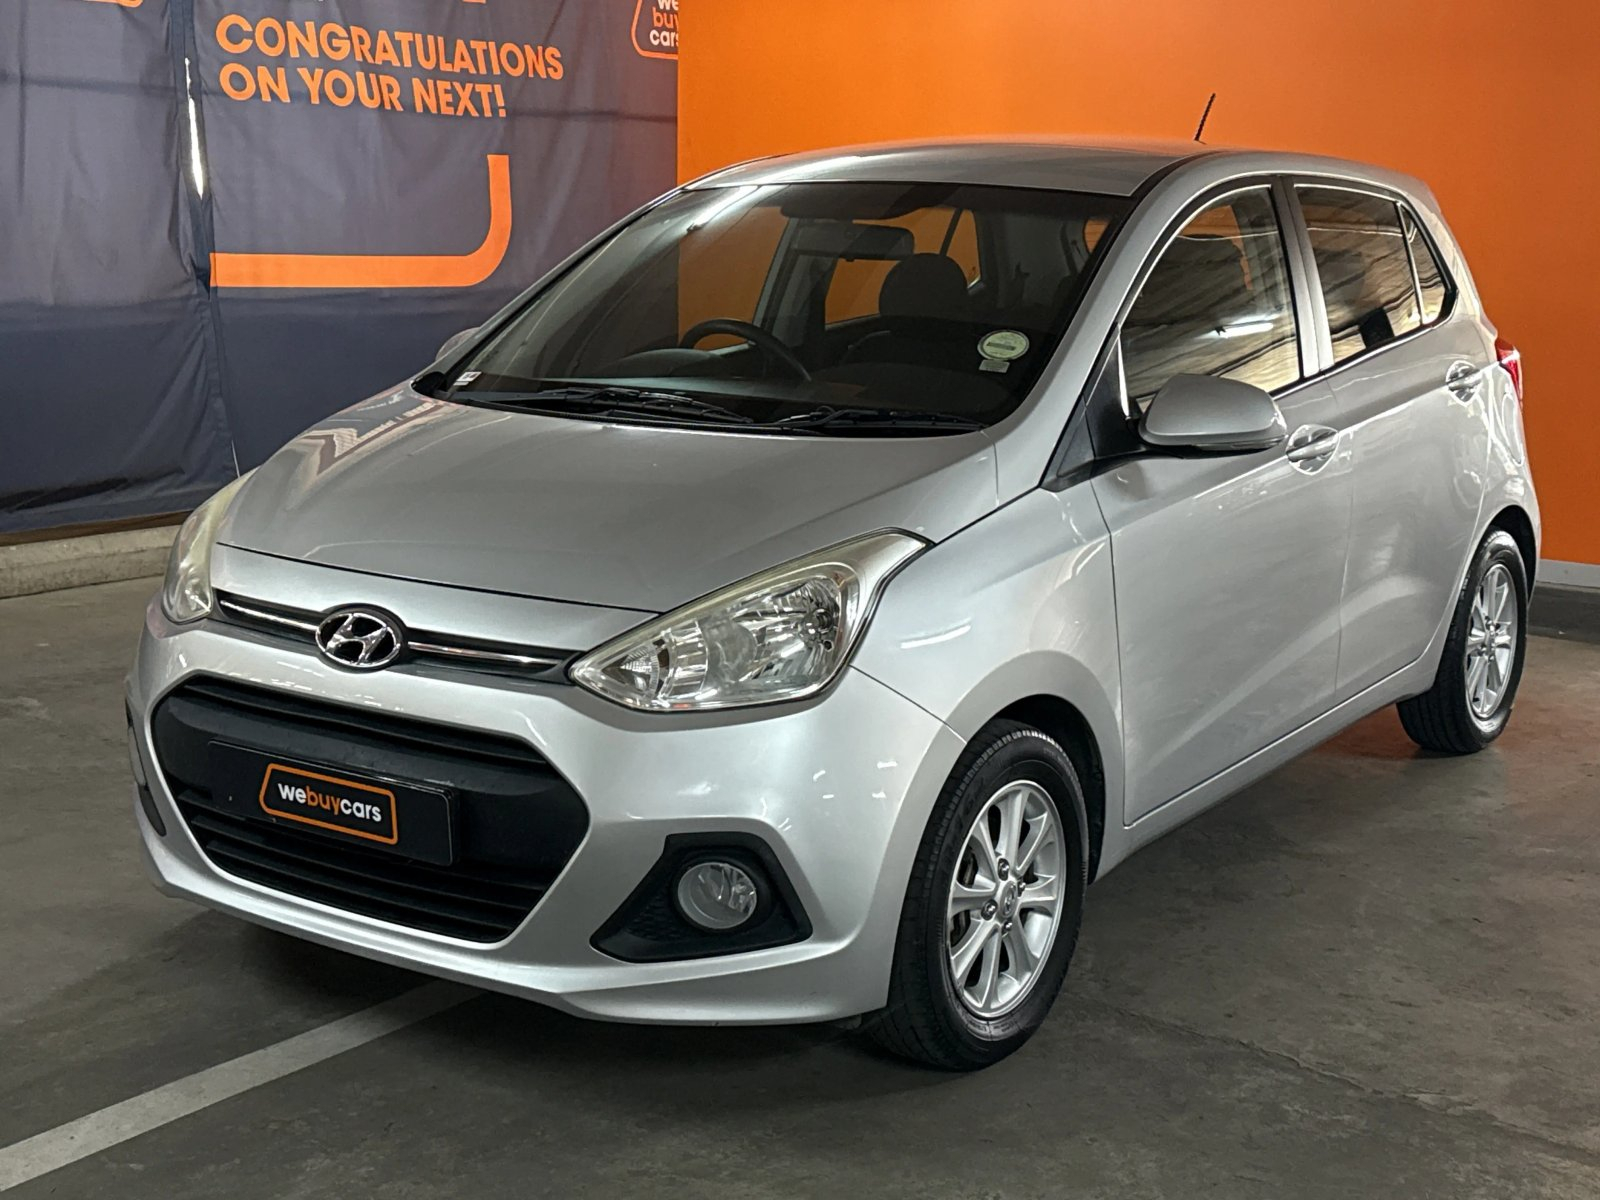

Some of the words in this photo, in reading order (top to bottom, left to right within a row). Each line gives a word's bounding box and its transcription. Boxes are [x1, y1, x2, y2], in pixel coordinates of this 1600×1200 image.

[215, 13, 564, 81] CONGRATULATIONS
[219, 62, 291, 103] ON
[296, 67, 404, 112] YOUR
[411, 77, 507, 118] NEXT!
[277, 782, 382, 823] webuycars
